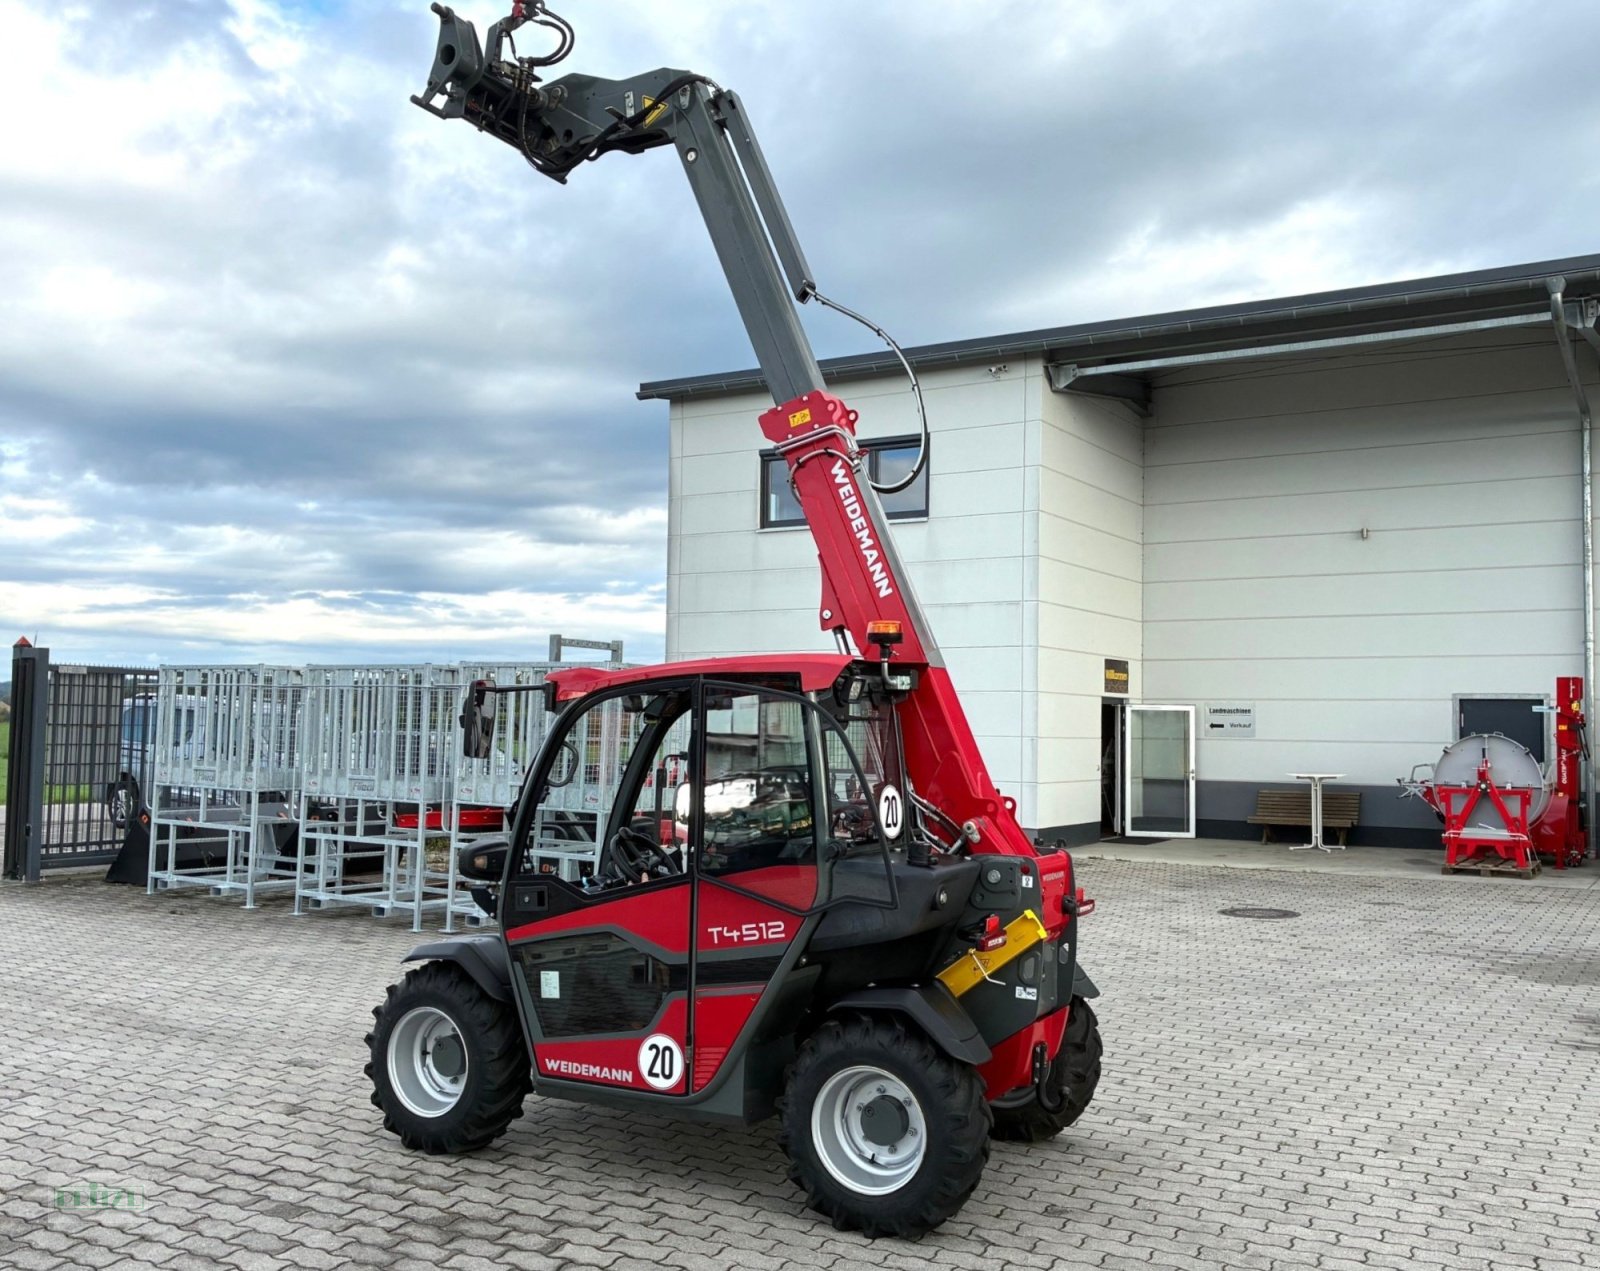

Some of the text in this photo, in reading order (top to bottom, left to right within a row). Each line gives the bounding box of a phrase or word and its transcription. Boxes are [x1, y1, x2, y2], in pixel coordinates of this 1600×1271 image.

[831, 459, 893, 599] WEIDEMANN
[884, 795, 898, 828] 20
[707, 921, 786, 944] T4512
[545, 1058, 633, 1083] WEIDEMANN
[647, 1043, 674, 1080] 20
